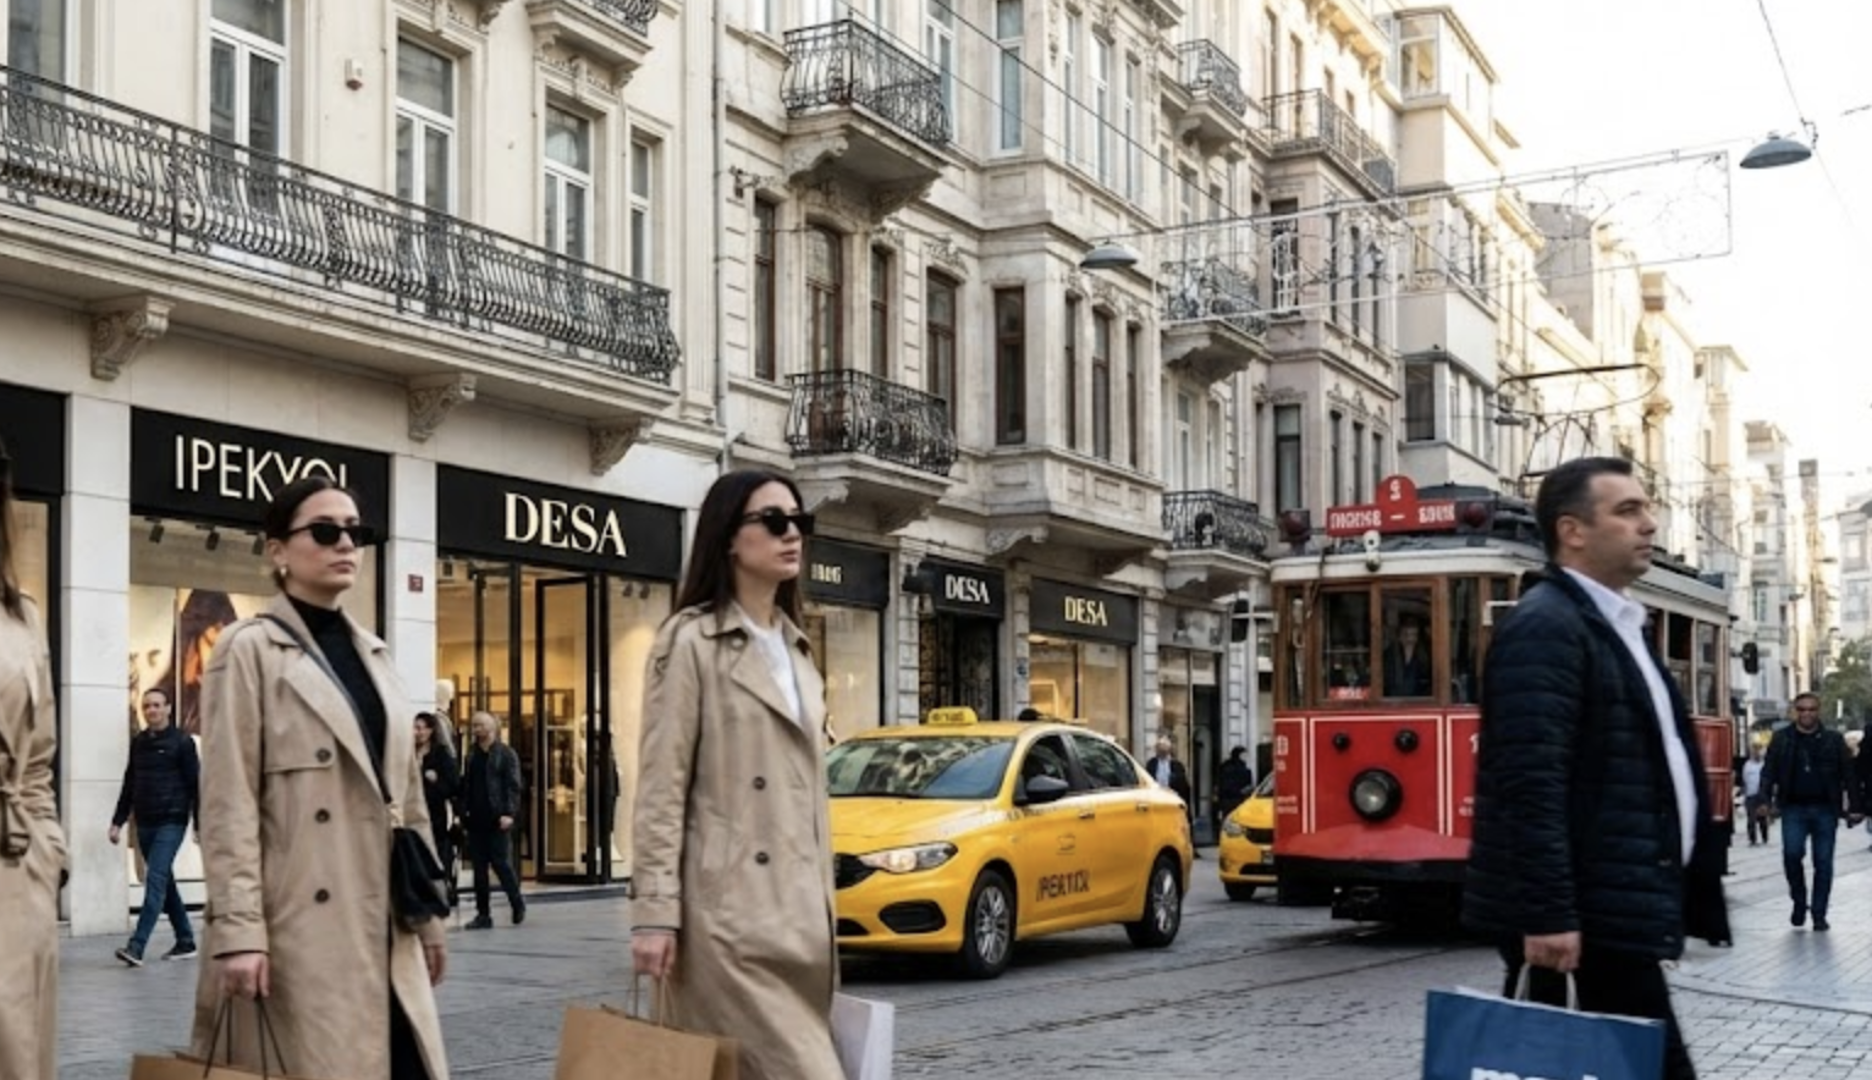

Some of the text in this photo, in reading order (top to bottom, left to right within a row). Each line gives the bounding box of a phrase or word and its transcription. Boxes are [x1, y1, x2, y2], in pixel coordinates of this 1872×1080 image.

[504, 492, 627, 558] DESA
[945, 573, 991, 605] DESA
[1064, 595, 1108, 627] DESA
